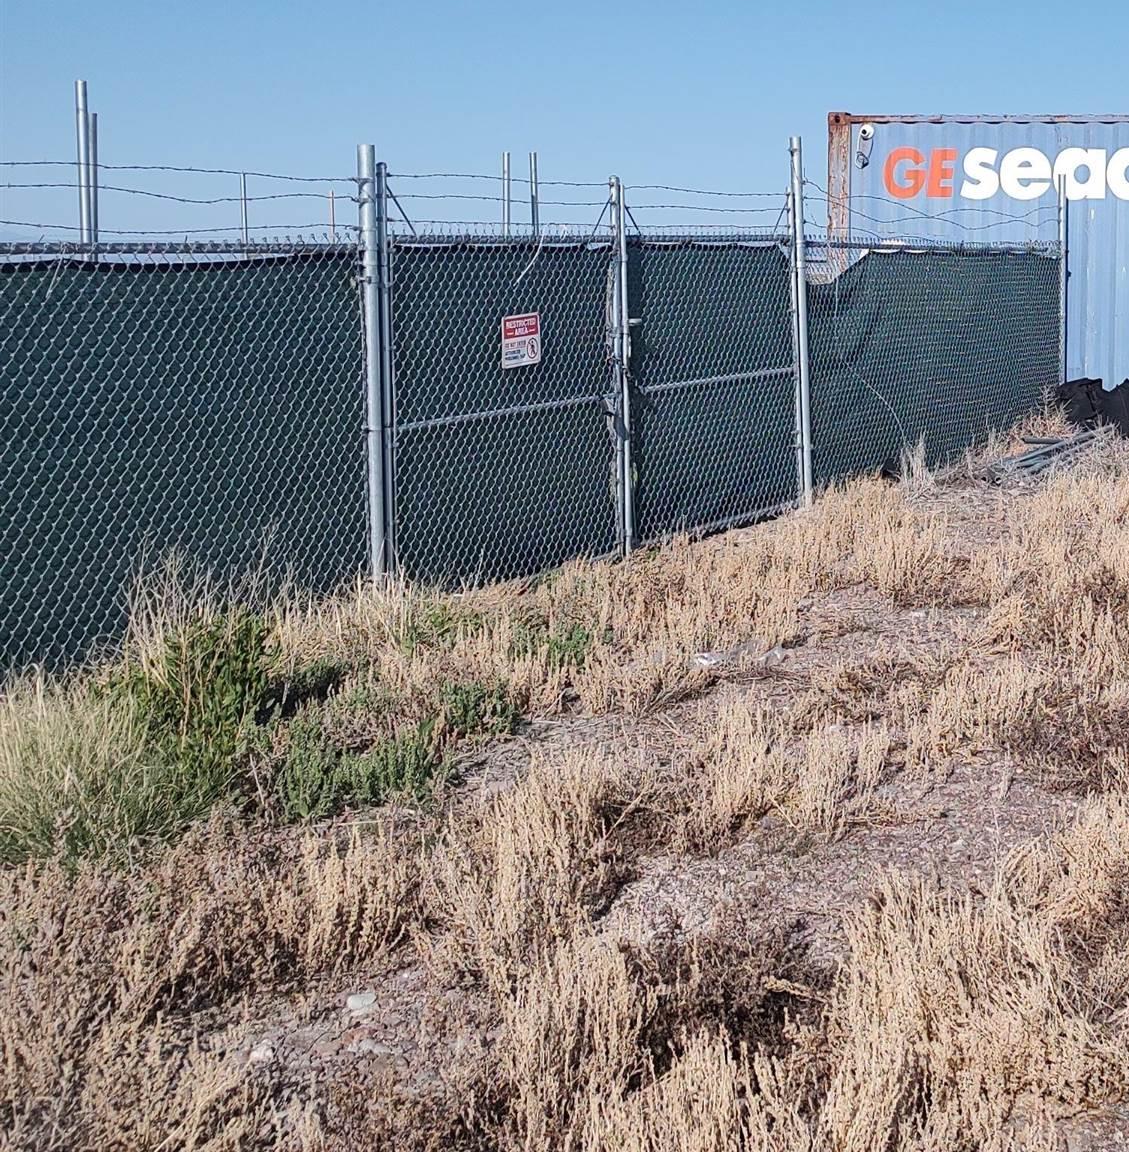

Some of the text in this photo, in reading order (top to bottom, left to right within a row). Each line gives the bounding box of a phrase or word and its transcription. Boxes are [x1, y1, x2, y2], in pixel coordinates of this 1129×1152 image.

[883, 145, 959, 200] GE
[506, 318, 537, 329] RESTRICTED
[514, 327, 529, 336] AREA
